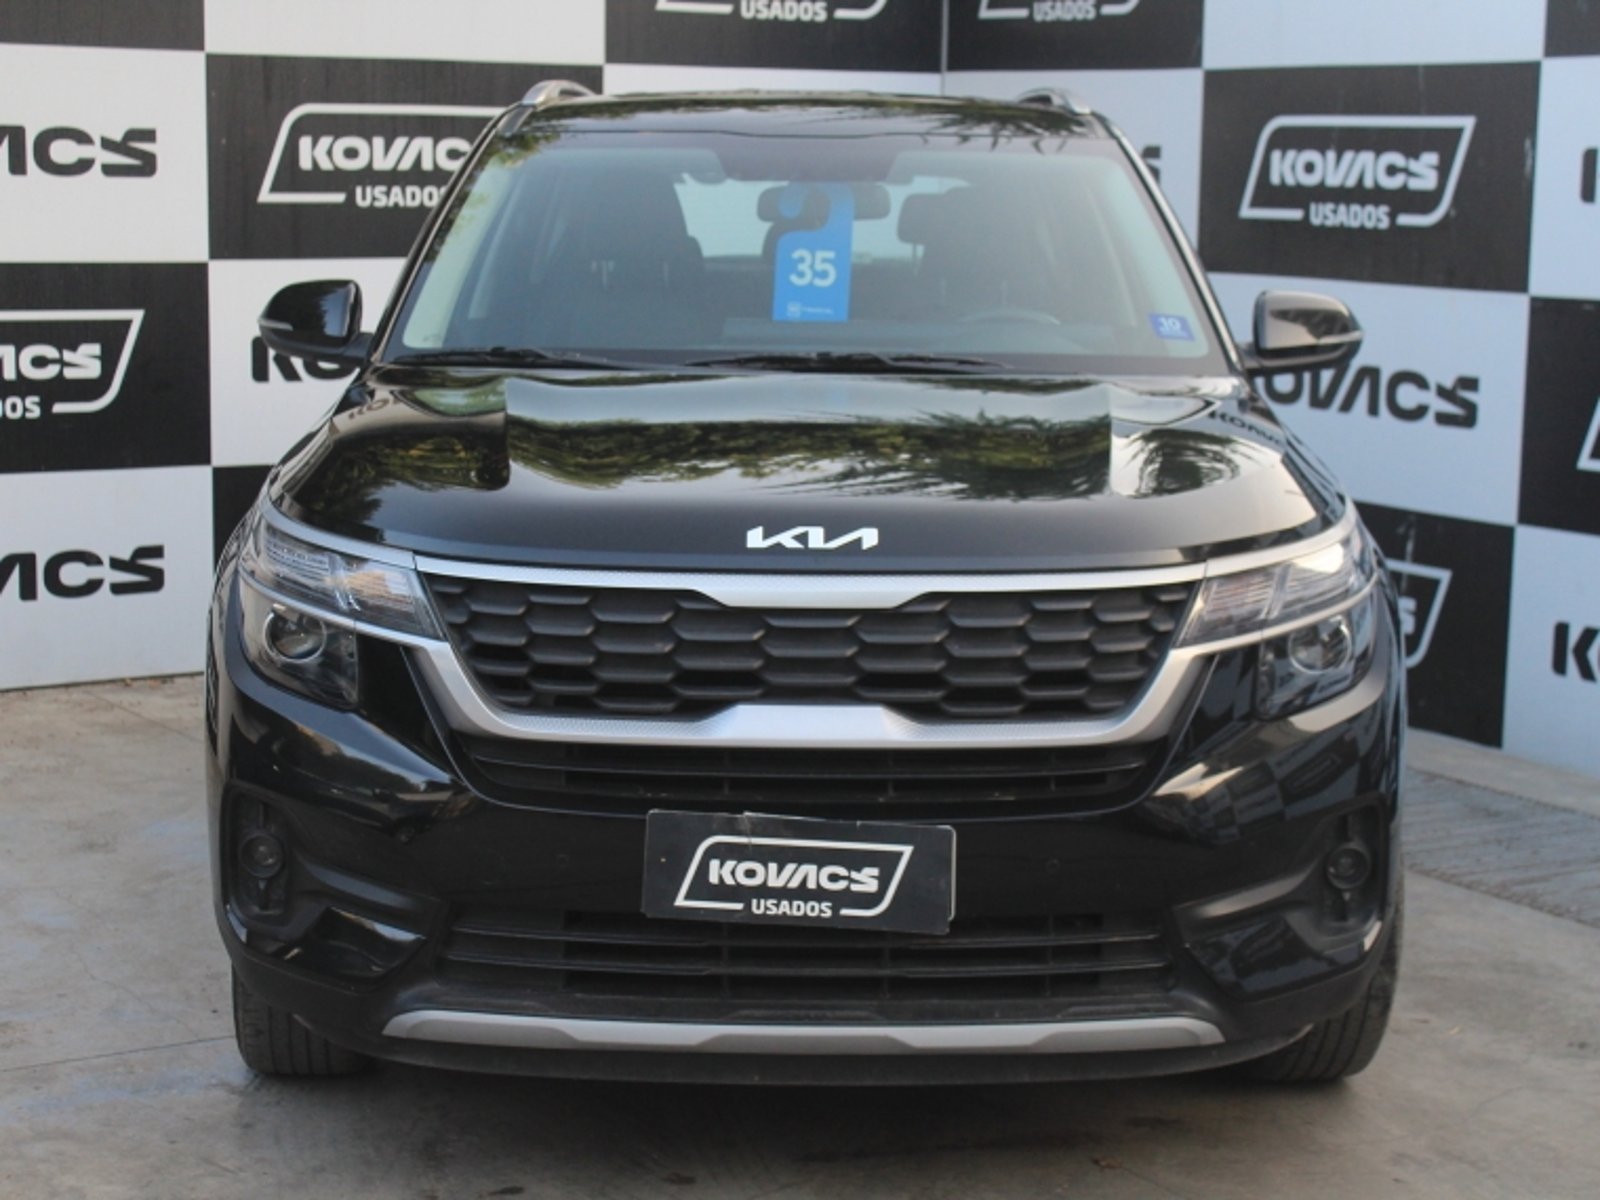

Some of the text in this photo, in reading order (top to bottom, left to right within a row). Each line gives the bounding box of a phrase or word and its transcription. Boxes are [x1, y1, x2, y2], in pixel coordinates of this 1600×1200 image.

[739, 0, 828, 22] USADOS
[1032, 0, 1096, 22] USADOS
[1269, 149, 1439, 191] KOVACS
[1309, 202, 1391, 230] USADOS
[788, 248, 837, 287] 35
[708, 858, 880, 893] KOVACS
[751, 898, 833, 918] USADOS
